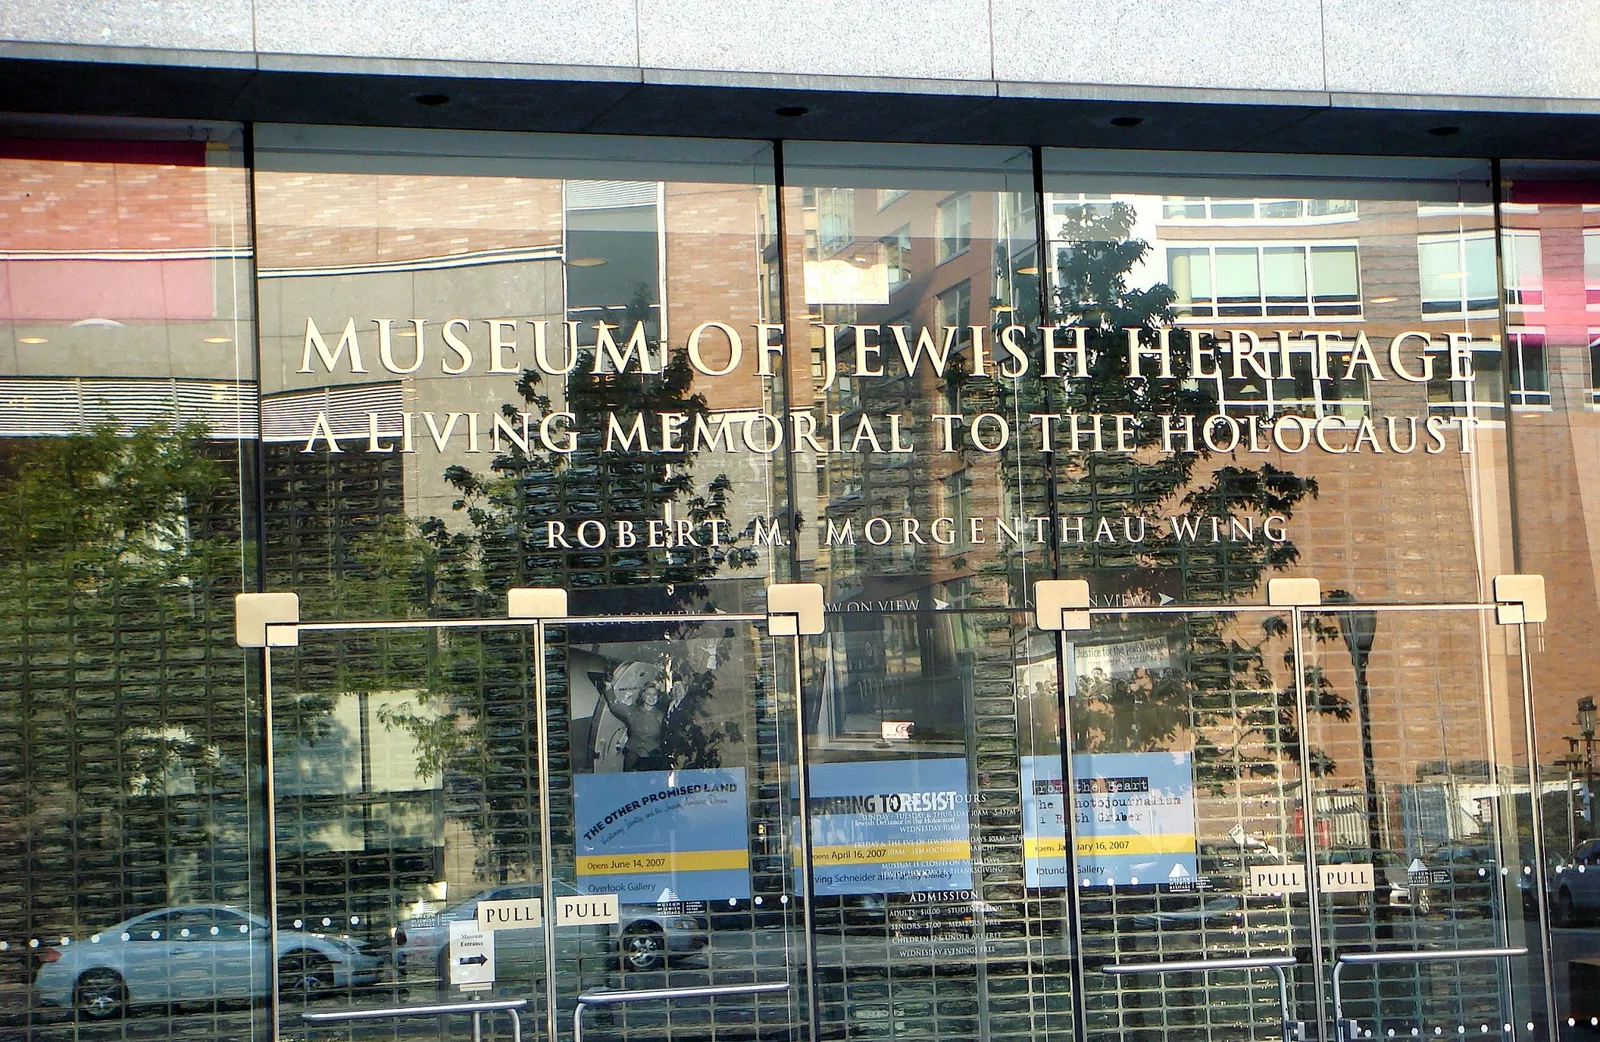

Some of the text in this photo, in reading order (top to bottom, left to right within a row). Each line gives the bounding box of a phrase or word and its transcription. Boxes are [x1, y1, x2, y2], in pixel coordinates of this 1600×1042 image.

[296, 317, 1476, 393] MUSEUM OF JEWISH HERITAGE
[300, 411, 1479, 455] A LIVING MEMORIAL TO THE HOLOCAUST
[546, 516, 1288, 549] ROBERT M. MORGENTHAU WING
[1104, 592, 1148, 608] VIEW
[1037, 780, 1148, 794] rom the Heart
[880, 793, 902, 813] TO
[901, 790, 957, 812] RESIST
[1039, 796, 1182, 810] he hotojournalism
[583, 784, 738, 841] THE OTHER PROMISED LAND
[896, 812, 924, 820] TUESDAY
[932, 809, 968, 818] THURSDAY
[1055, 813, 1089, 824] Rth
[854, 818, 875, 827] Jewish
[876, 818, 904, 826] Defiance
[912, 817, 923, 825] the
[924, 816, 955, 825] Holocaust
[899, 825, 941, 833] WEDNESDAY
[943, 823, 960, 832] 10AM
[854, 841, 880, 849] FRIDAY
[1057, 843, 1094, 853] Jauary
[1096, 842, 1107, 851] 16,
[1109, 841, 1130, 850] 2007
[811, 849, 887, 862] pens April 16, 2007
[587, 858, 666, 871] Opens June 14, 2007
[920, 860, 949, 868] CLOSED
[951, 865, 1004, 874] THANKSGIVING
[1036, 865, 1067, 875] otund
[815, 876, 836, 886] ving
[834, 872, 876, 883] Schneider
[1258, 872, 1300, 887] PULL
[1327, 871, 1368, 885] PULL
[588, 881, 657, 893] Overlook Gallery
[910, 890, 979, 902] ADMISSION
[486, 906, 535, 923] PULL
[564, 902, 612, 919] PULL
[892, 936, 929, 944] CHILDREN
[971, 932, 985, 940] ARE
[899, 945, 996, 957] WEDNESDAY EVENINGS FREE
